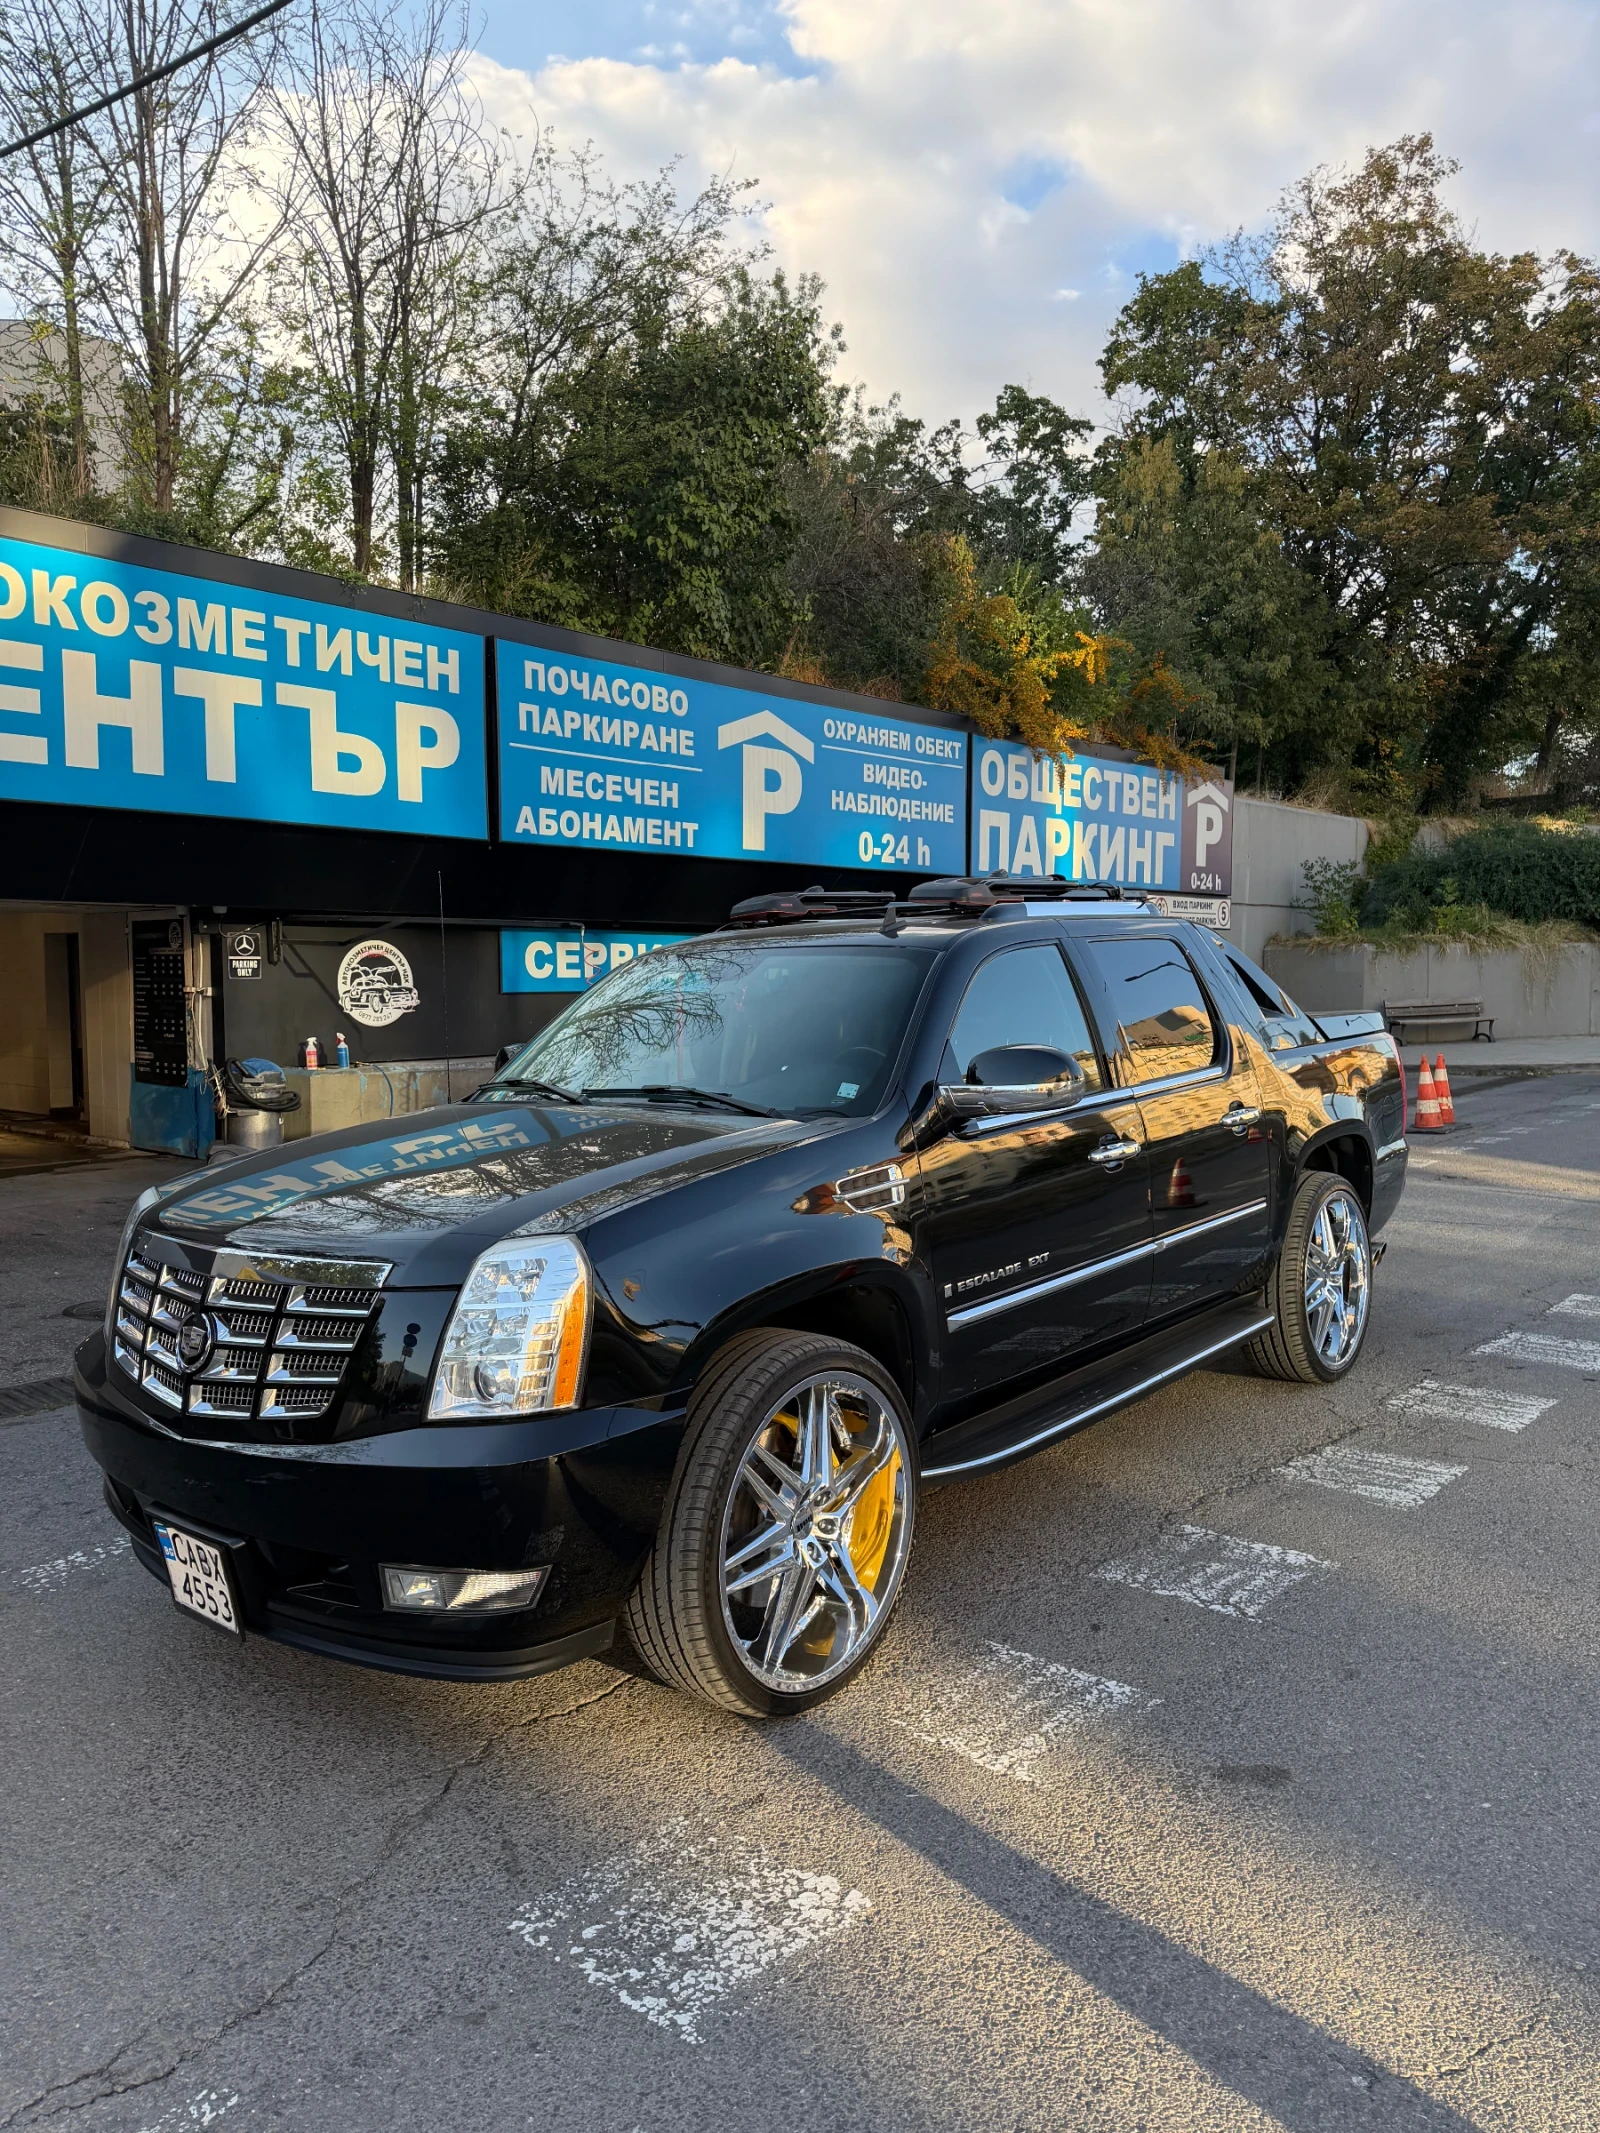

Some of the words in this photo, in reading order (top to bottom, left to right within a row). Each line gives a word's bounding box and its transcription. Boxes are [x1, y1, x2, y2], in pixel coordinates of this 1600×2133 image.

[524, 660, 688, 717] ПОЧАСОВО
[518, 702, 695, 757] ПАРКИРАНЕ
[823, 718, 910, 752] ОХРАНЯЕМ
[915, 736, 962, 760] ОБЕКТ
[540, 767, 679, 808] МЕСЕЧЕН
[742, 744, 802, 851] P
[863, 763, 927, 791] ВИДЕО-
[980, 749, 1176, 821] ОБЩЕСТВЕН
[515, 806, 698, 848] АБОНАМЕНТ
[831, 789, 954, 824] НАБЛЮДЕНИЕ
[859, 831, 909, 864] 0-24
[918, 837, 931, 867] h
[978, 809, 1175, 885] ПАРКИНГ
[1195, 802, 1223, 867] P
[1191, 872, 1213, 890] 0-24
[1216, 874, 1221, 890] h
[1173, 900, 1188, 910] ВХОД
[1189, 901, 1214, 910] ПАРКИНГ
[1221, 906, 1227, 921] 5
[232, 960, 258, 969] PARKING
[237, 968, 252, 977] ONLY
[957, 1262, 1021, 1293] ESCALADE
[1028, 1252, 1050, 1268] EXT
[163, 1546, 175, 1556] BG
[182, 1572, 233, 1622] 4553
